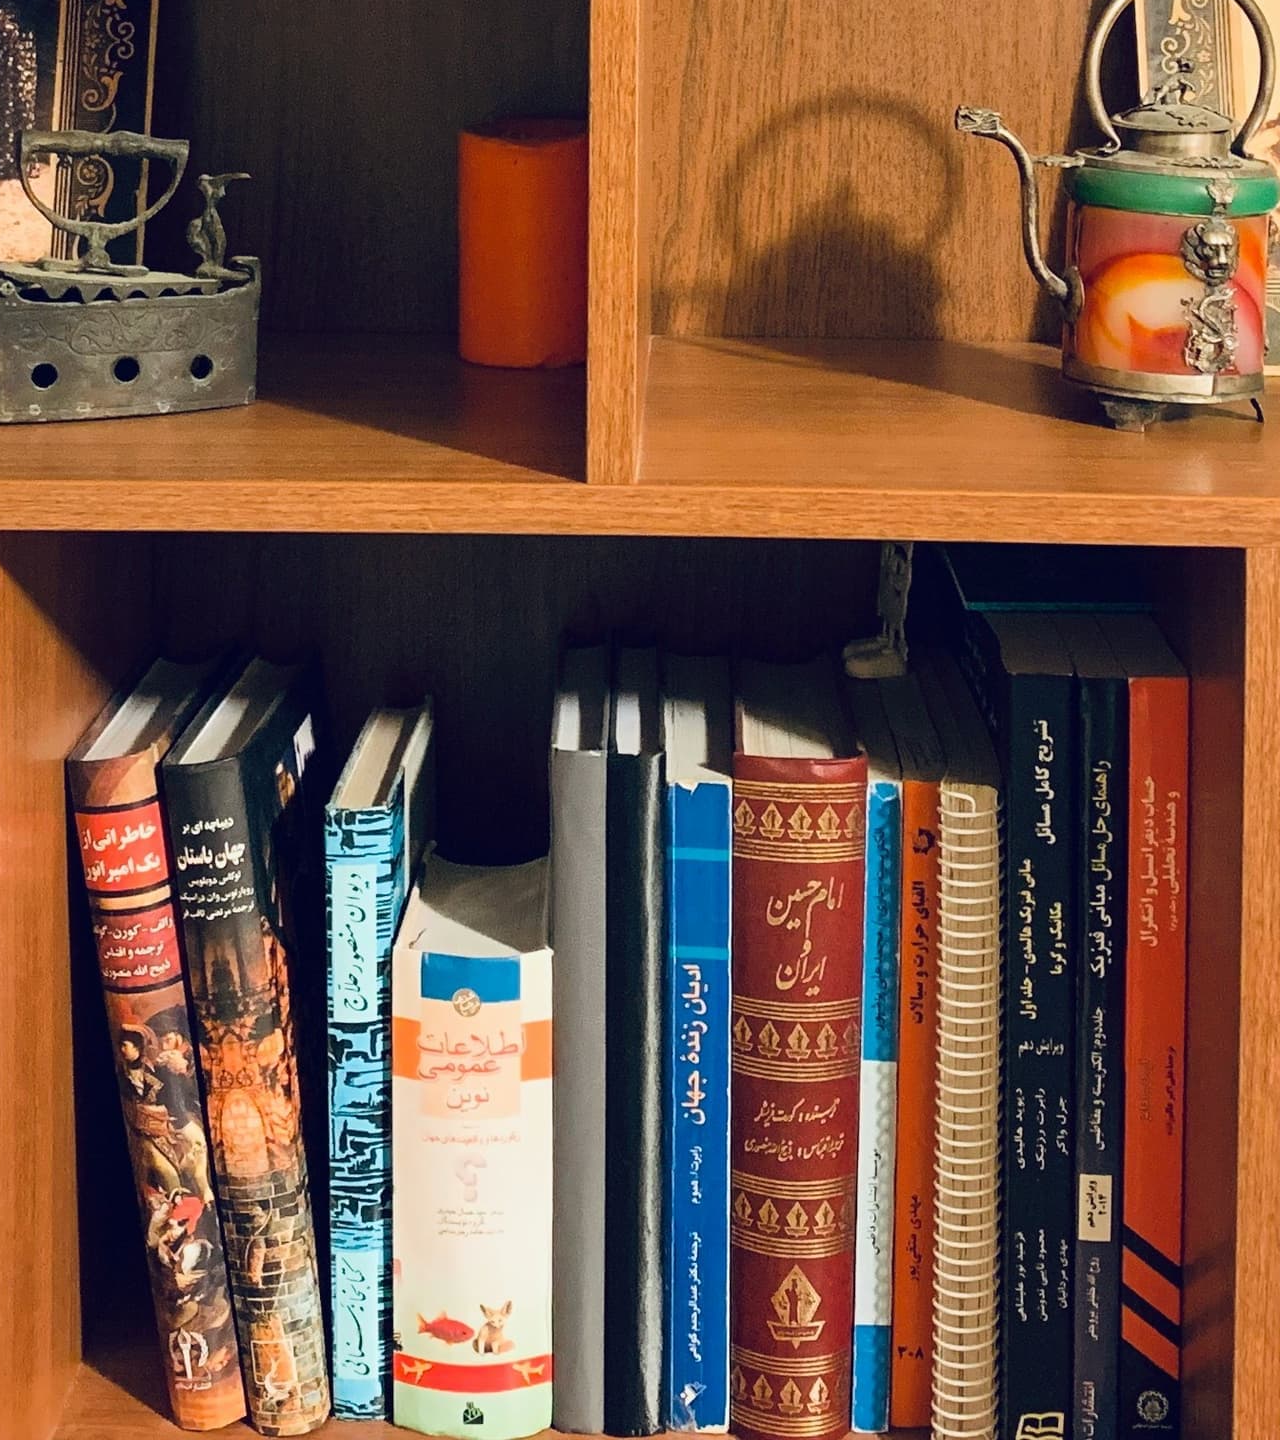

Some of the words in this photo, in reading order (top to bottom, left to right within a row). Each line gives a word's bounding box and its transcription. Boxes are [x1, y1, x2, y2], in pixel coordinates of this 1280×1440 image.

[1032, 719, 1054, 762] تشریح
[1034, 766, 1055, 800] کامل
[1035, 803, 1057, 845] مسائل
[176, 846, 214, 871] باستان
[214, 841, 246, 869] جهان
[680, 964, 709, 1016] ادیان
[416, 1027, 527, 1058] اطلاعات
[417, 1057, 502, 1082] عمومی
[445, 1086, 491, 1113] نوین
[679, 1070, 709, 1125] جهان
[897, 1345, 924, 1360] ۳۰۸
